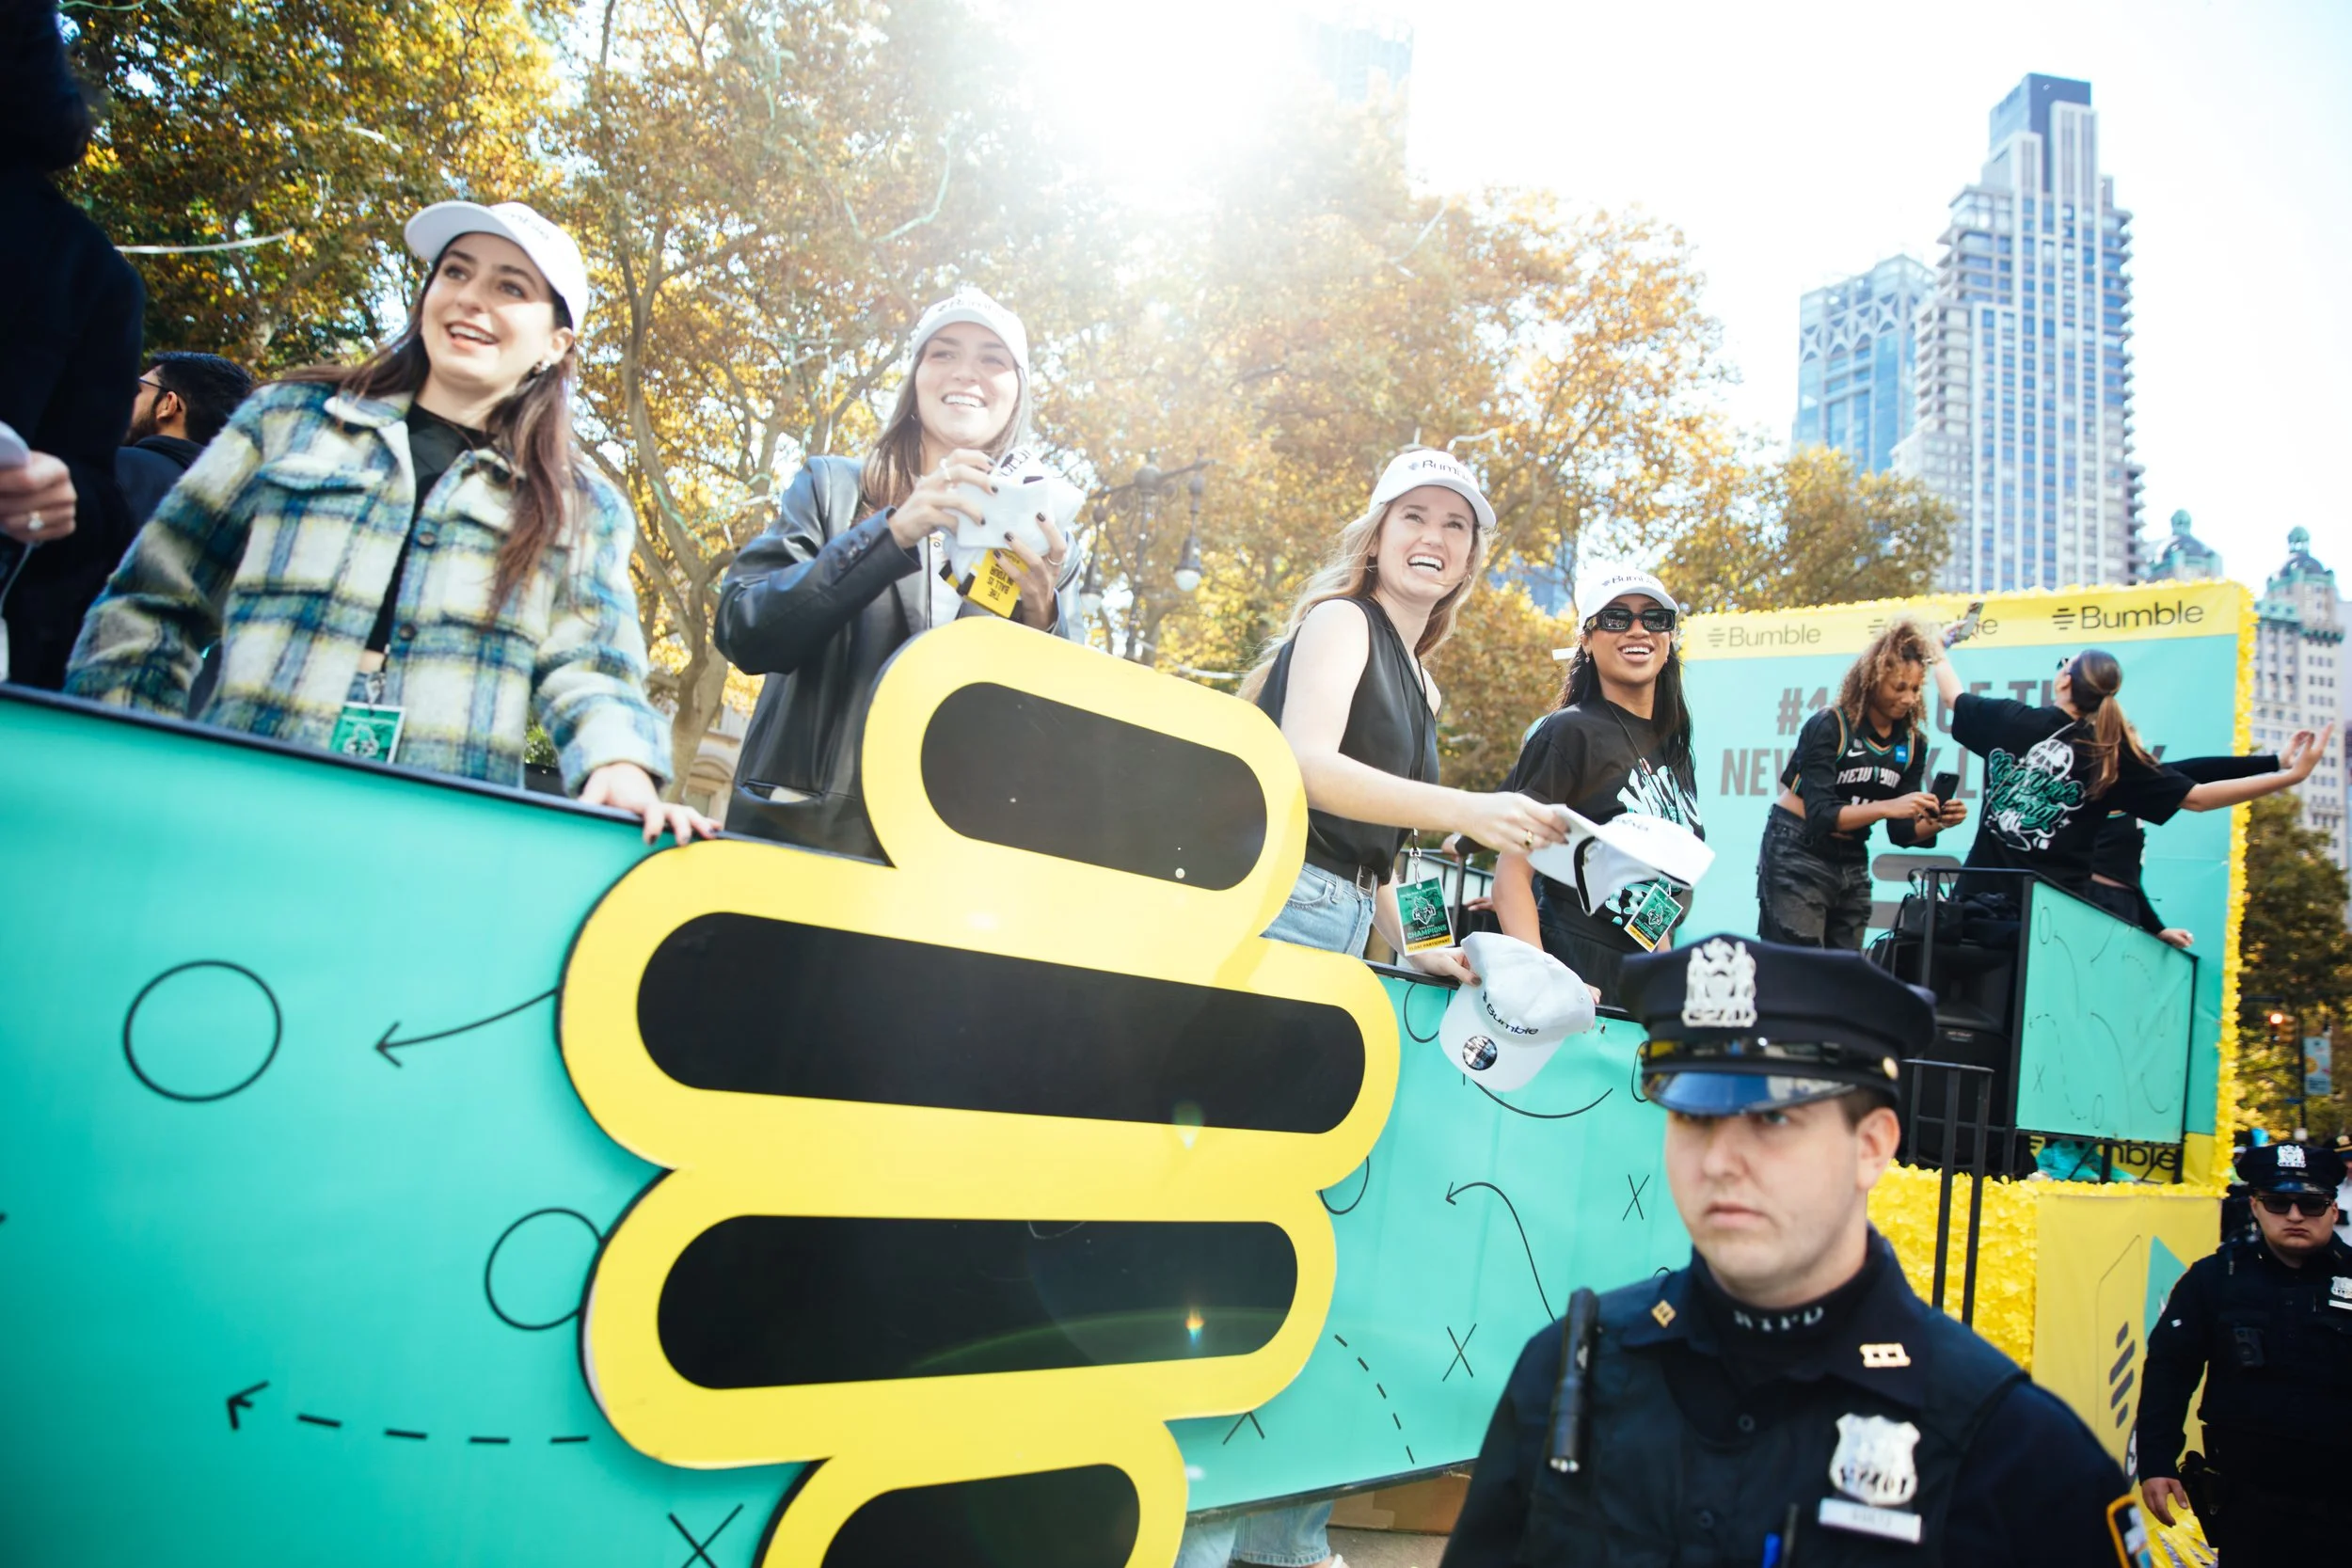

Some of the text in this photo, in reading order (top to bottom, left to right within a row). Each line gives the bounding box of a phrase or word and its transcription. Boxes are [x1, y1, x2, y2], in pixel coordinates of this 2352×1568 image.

[988, 588, 1000, 601] THE
[993, 579, 1009, 594] BALL
[2081, 600, 2204, 629] Bumble
[1728, 625, 1821, 647] Bumble
[1836, 767, 1900, 788] NEW YOR
[1990, 750, 2026, 784] New
[2019, 767, 2080, 807] York
[1406, 924, 1447, 940] CHAMPIONS
[1486, 1004, 1538, 1035] Bumble
